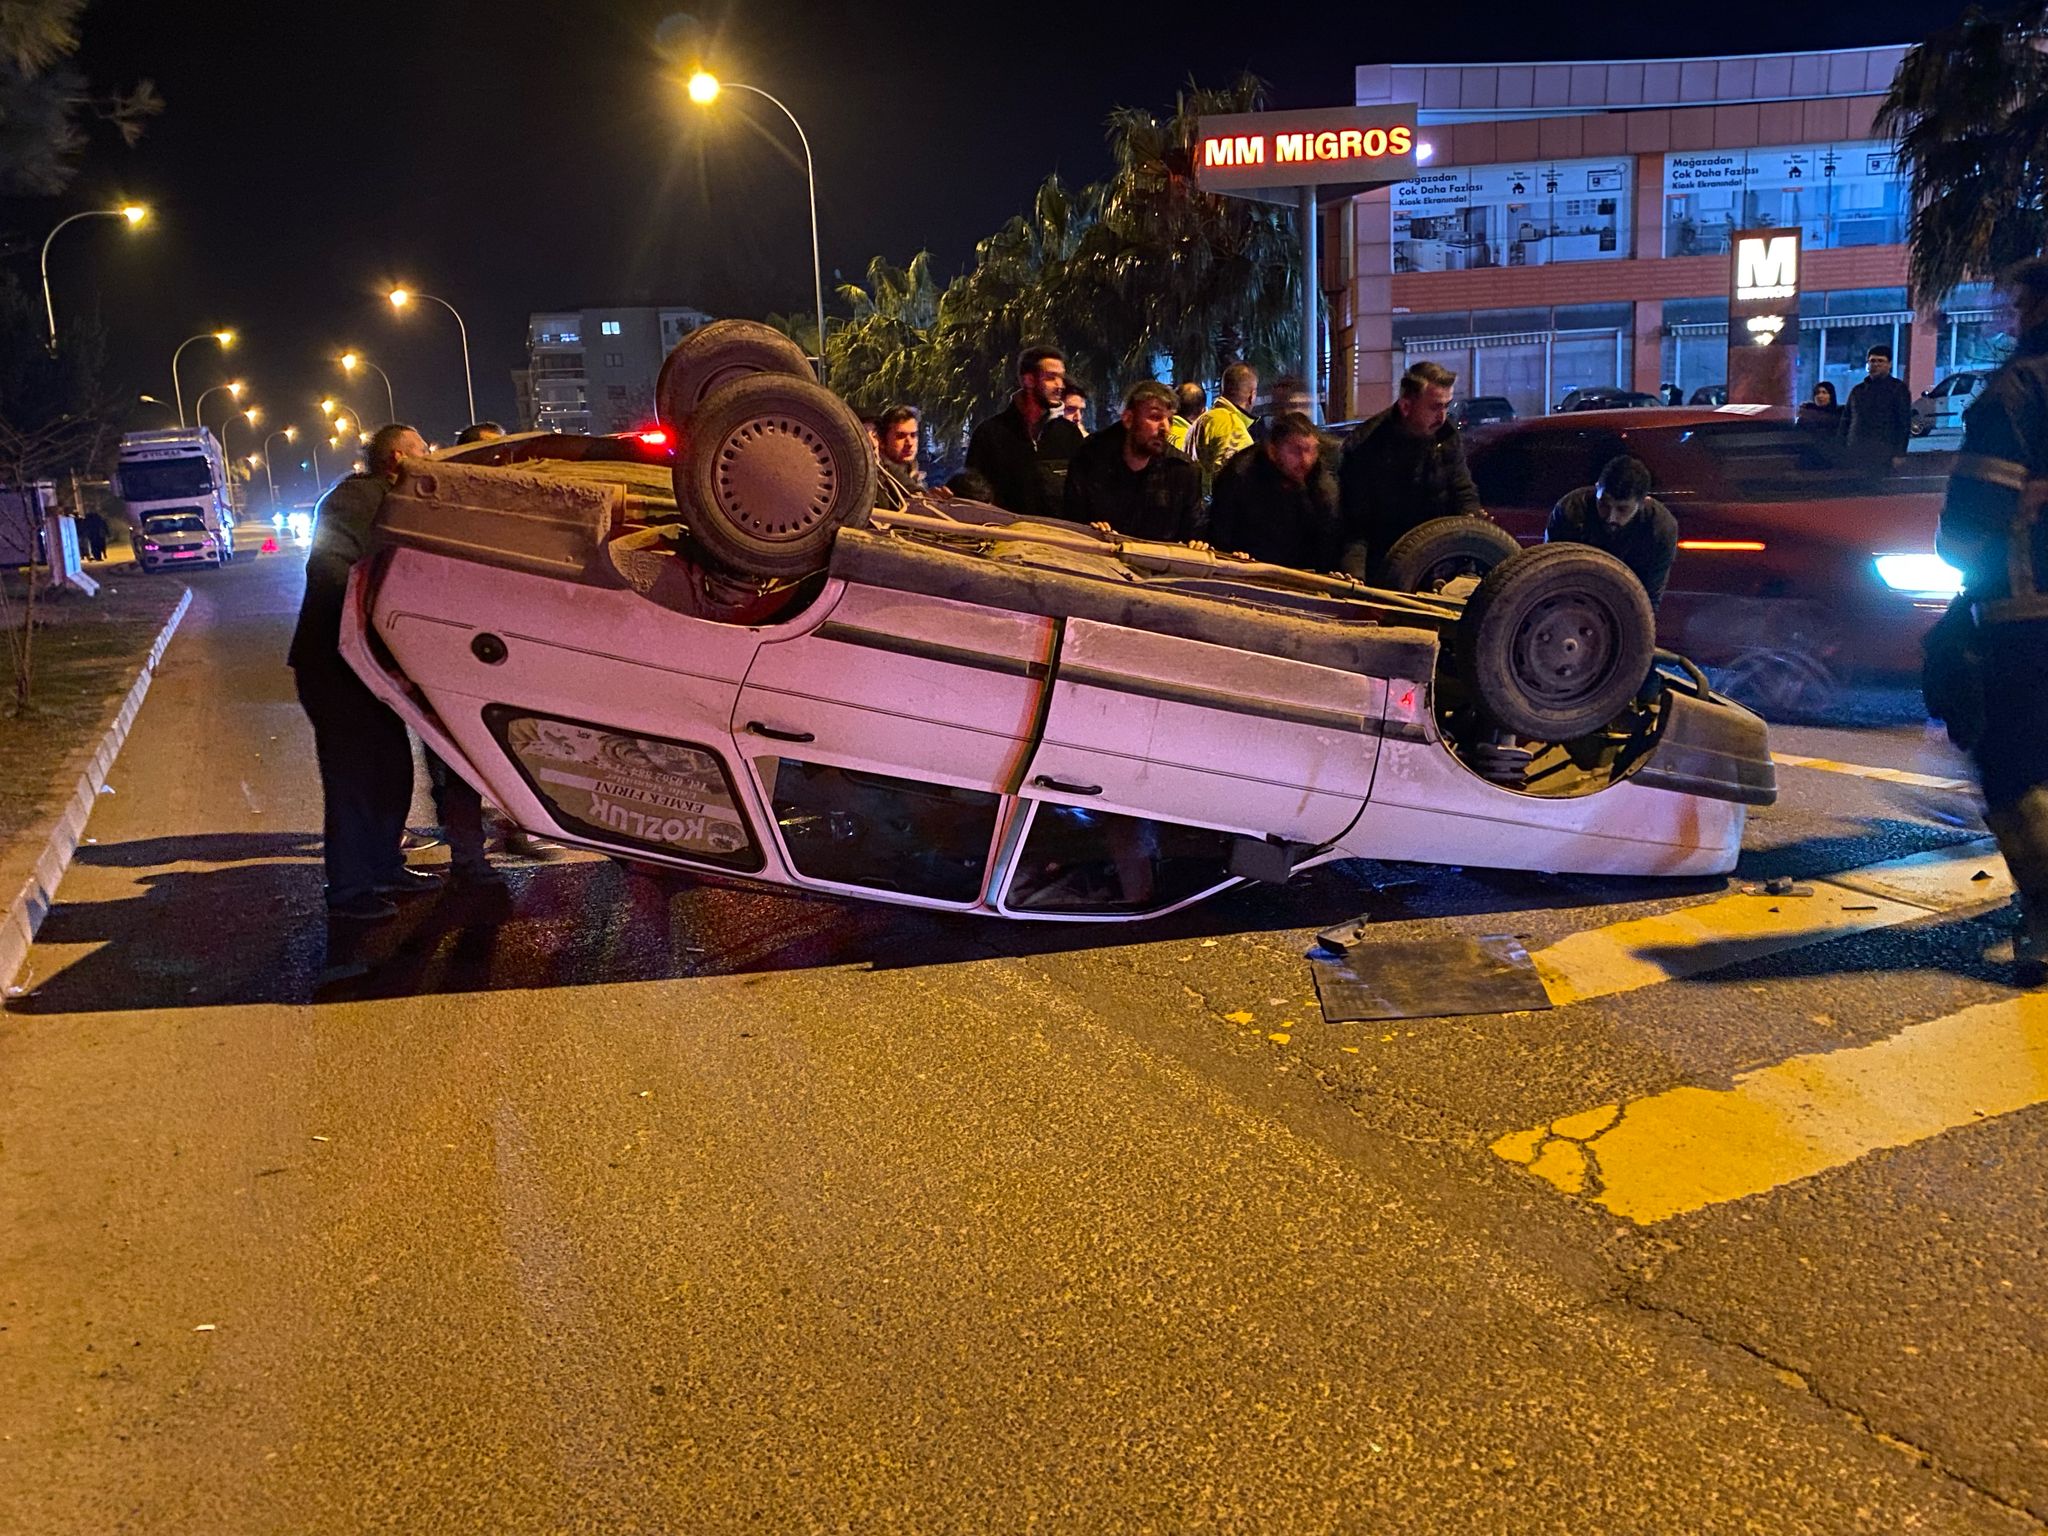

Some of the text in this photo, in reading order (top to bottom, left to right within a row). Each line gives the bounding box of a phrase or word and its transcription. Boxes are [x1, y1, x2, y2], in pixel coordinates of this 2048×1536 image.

[1205, 137, 1264, 166] MM
[1672, 156, 1733, 168] Mağazadan
[1672, 166, 1759, 180] Çok Daha Fazlası
[1399, 183, 1482, 196] Çok Daha Fazlası
[1672, 180, 1695, 189] Kiosk
[1399, 197, 1421, 206] Kiosk
[1738, 236, 1796, 287] M
[595, 782, 704, 813] EKMEK FIRINI
[588, 792, 705, 842] KOZLUK
